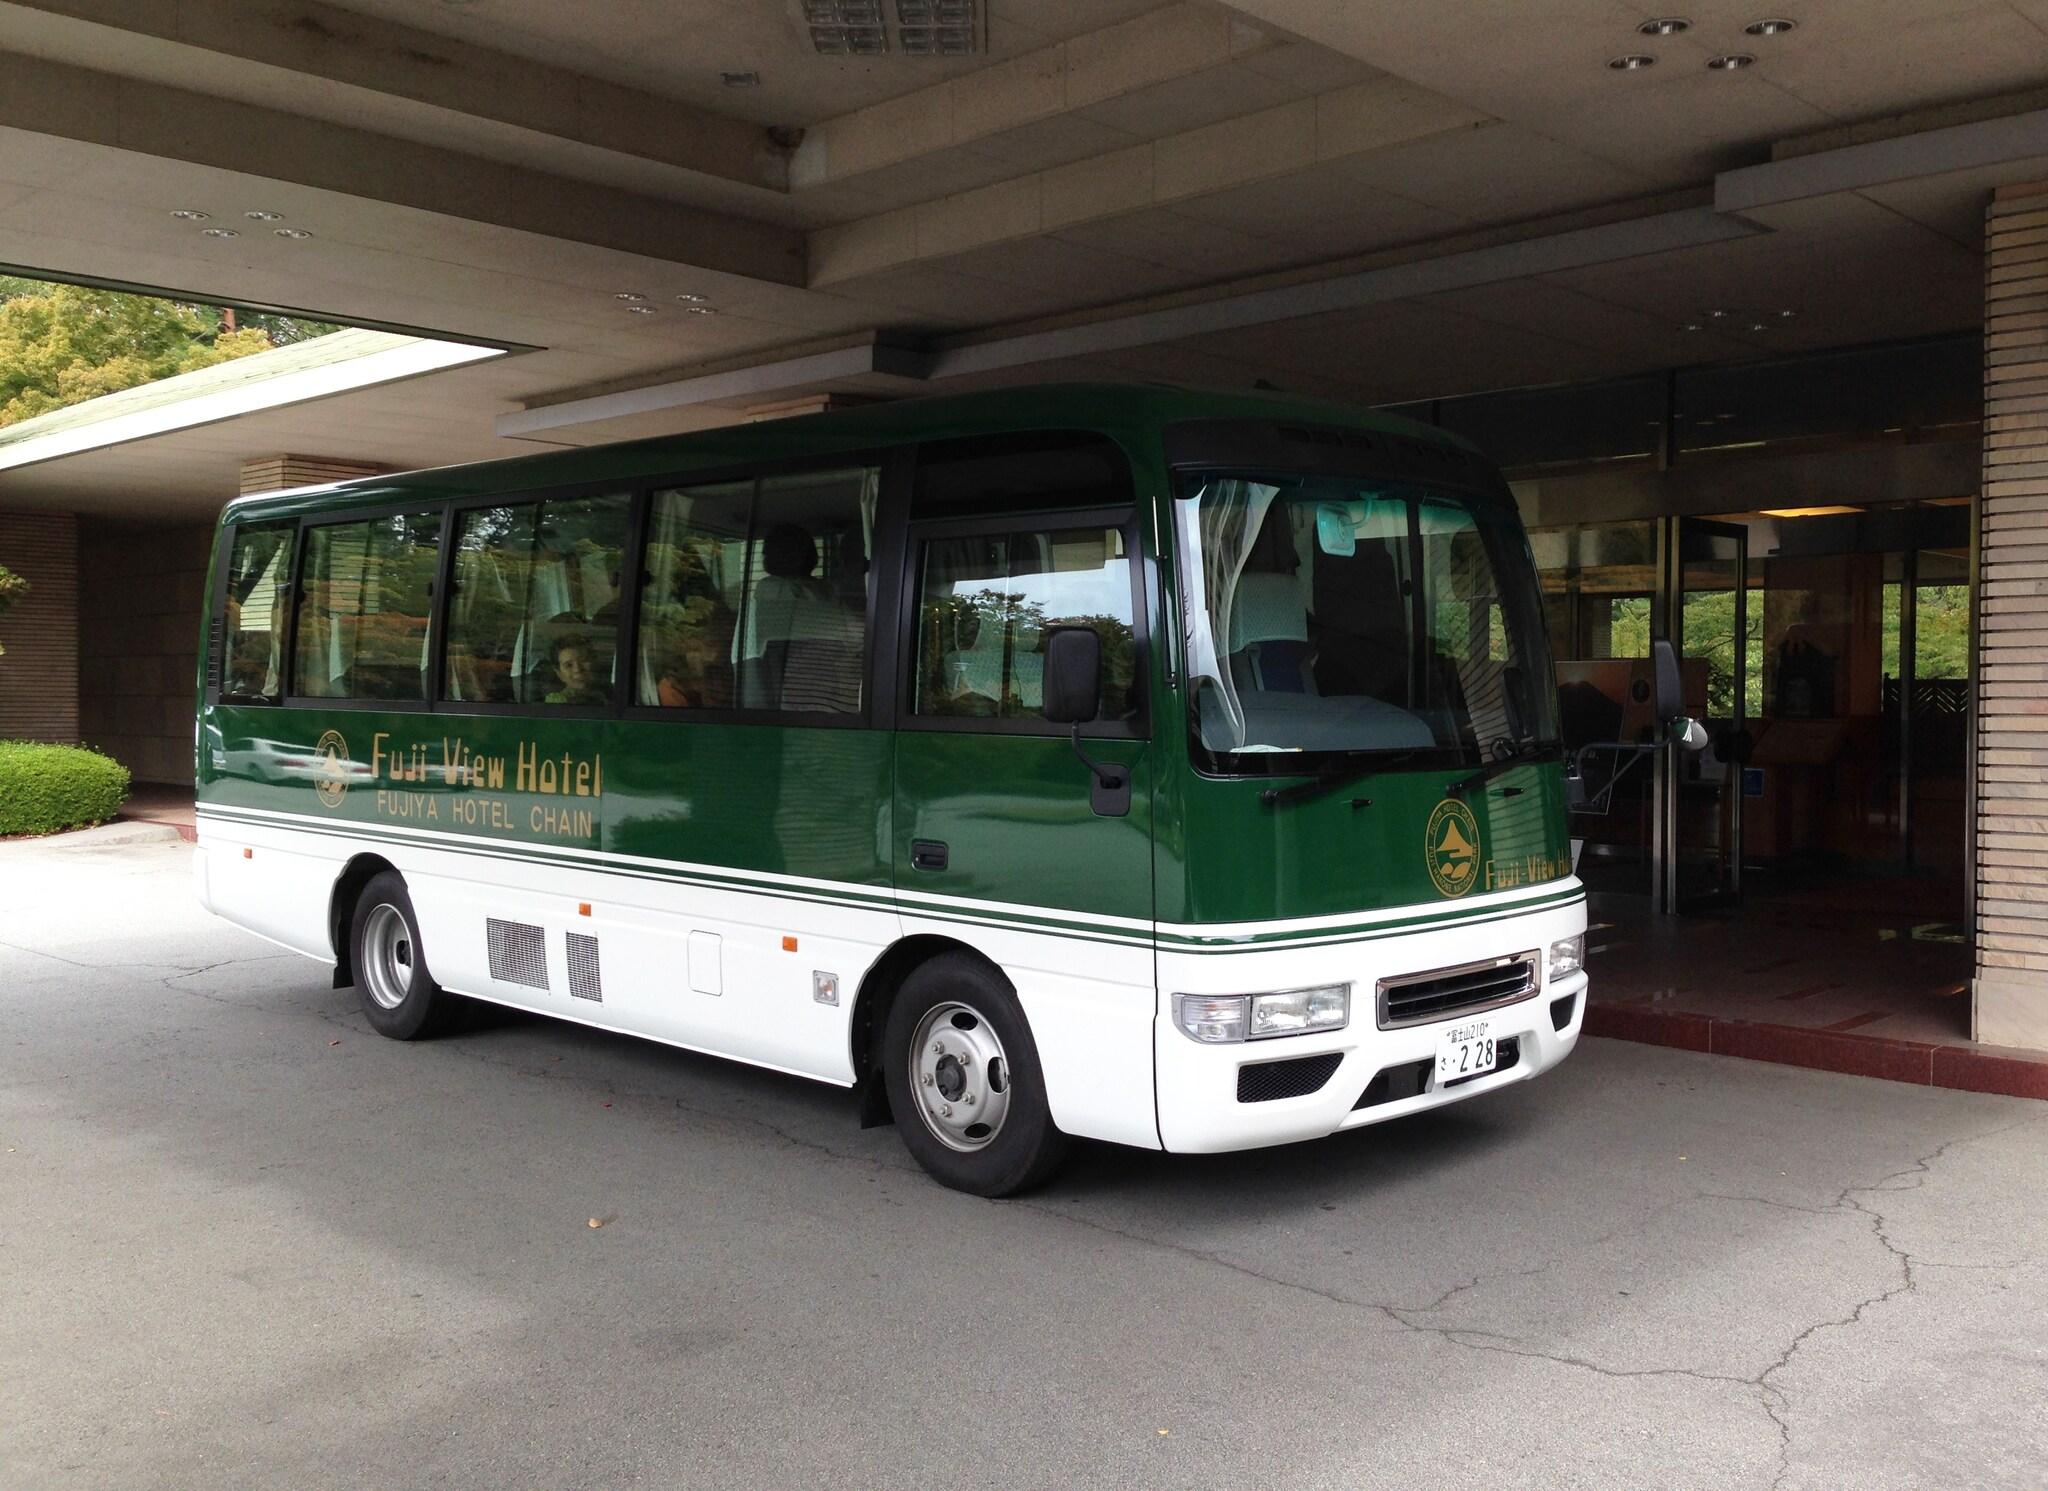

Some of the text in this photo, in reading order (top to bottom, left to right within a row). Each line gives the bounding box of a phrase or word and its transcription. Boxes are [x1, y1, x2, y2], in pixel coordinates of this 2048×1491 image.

[371, 733, 427, 783] Fuji
[443, 736, 504, 789] View
[516, 741, 601, 797] Hotel
[377, 790, 592, 838] FUJIYA HOTEL CHAIN
[1485, 860, 1519, 890] Fuji
[1526, 854, 1555, 882] View
